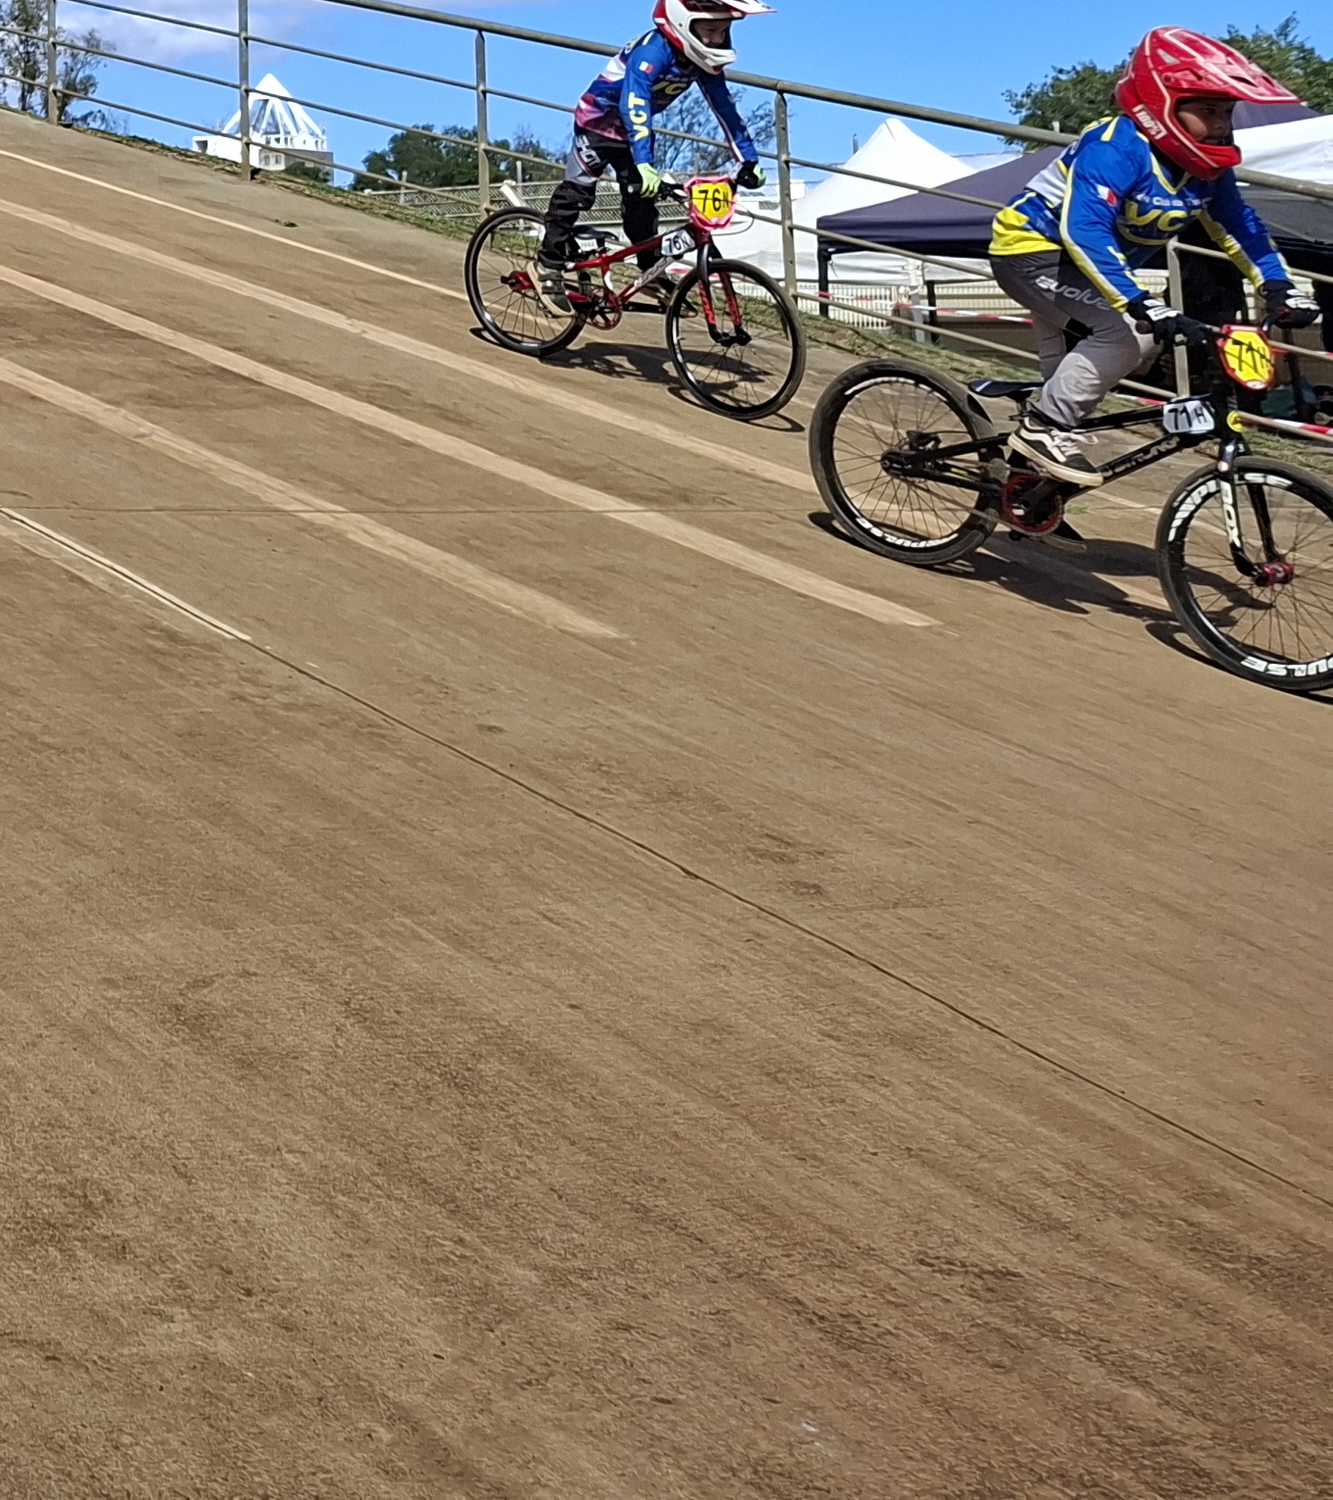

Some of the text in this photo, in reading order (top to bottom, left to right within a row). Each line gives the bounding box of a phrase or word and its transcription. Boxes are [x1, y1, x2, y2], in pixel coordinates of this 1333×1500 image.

[628, 92, 650, 141] VCT
[1134, 109, 1164, 137] 100%
[576, 134, 602, 167] SHOT
[698, 188, 730, 213] 76N
[1167, 407, 1208, 431] 71H
